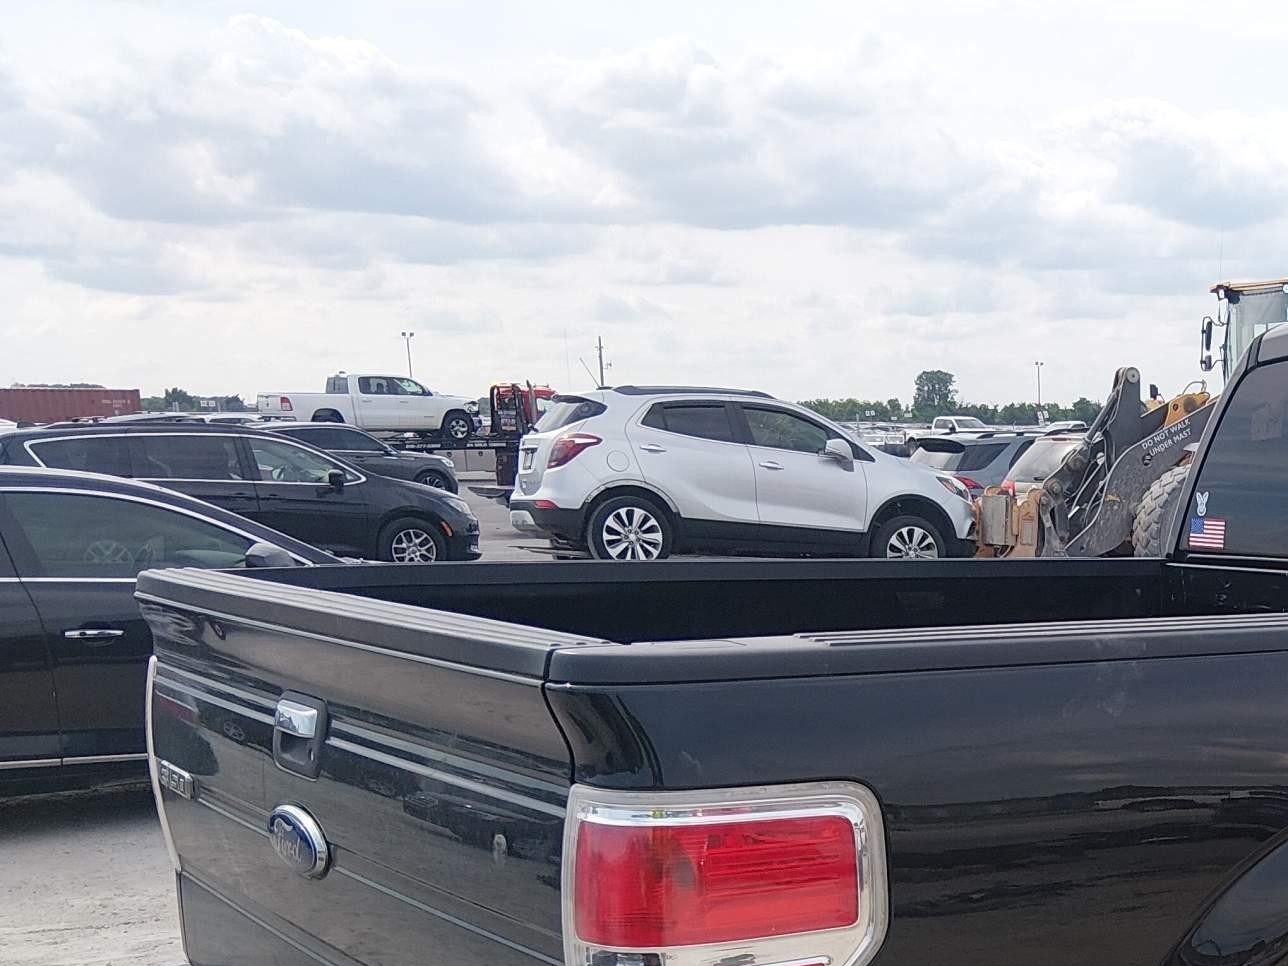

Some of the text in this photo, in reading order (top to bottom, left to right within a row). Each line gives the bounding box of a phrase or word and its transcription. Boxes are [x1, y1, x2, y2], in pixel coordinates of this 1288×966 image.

[1142, 418, 1191, 450] DO NOT WALK
[1149, 428, 1192, 456] UNDER MAST
